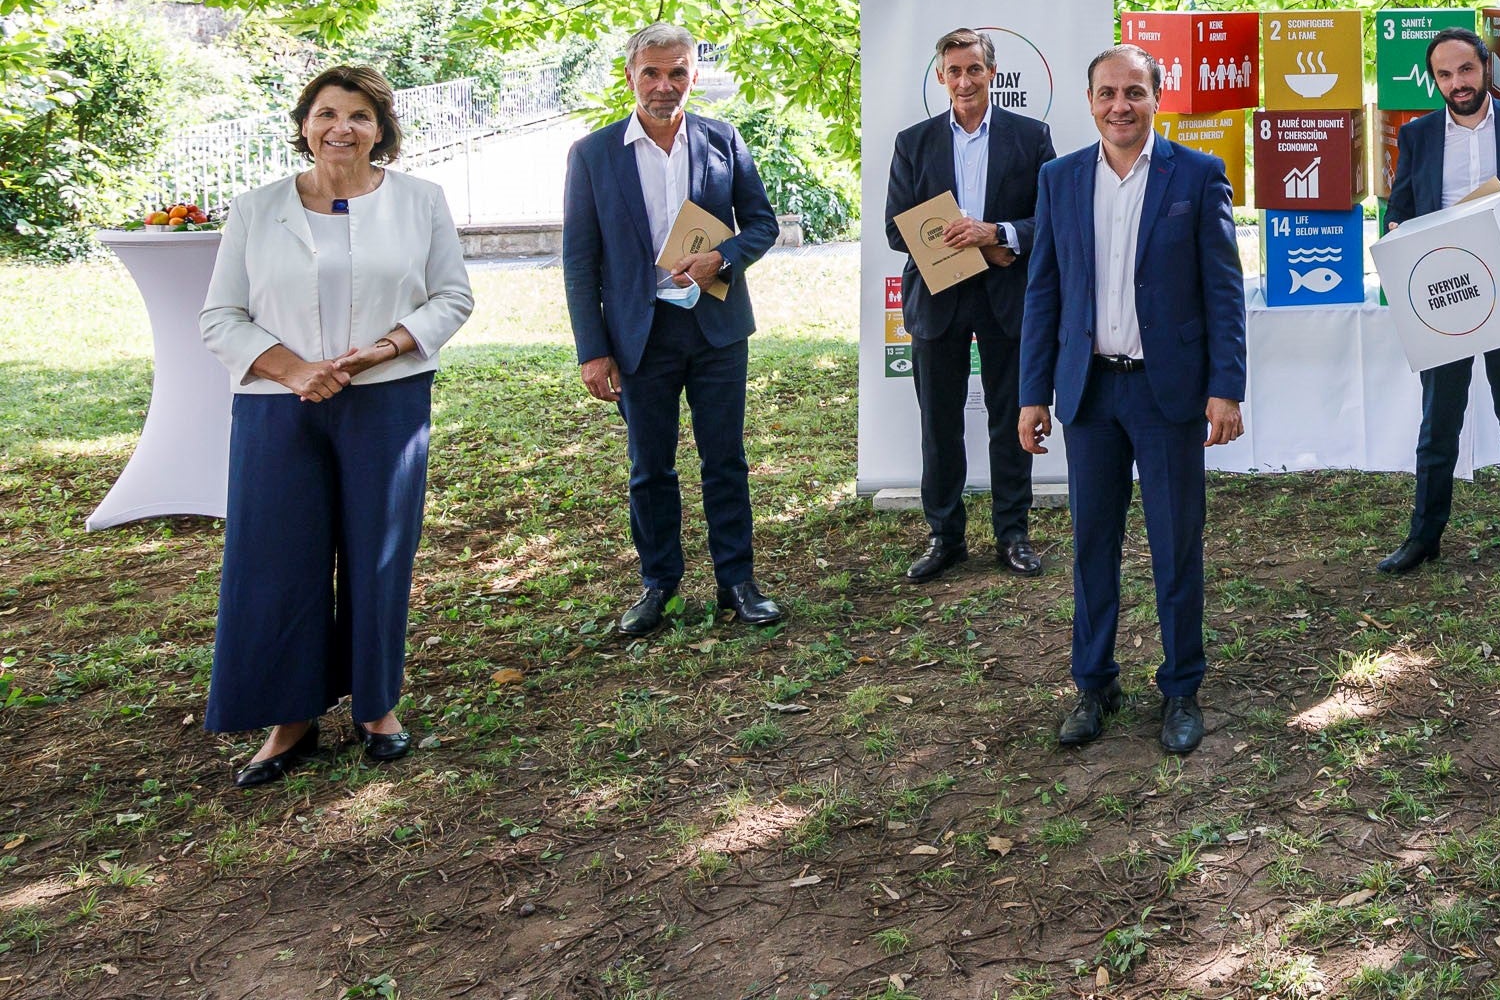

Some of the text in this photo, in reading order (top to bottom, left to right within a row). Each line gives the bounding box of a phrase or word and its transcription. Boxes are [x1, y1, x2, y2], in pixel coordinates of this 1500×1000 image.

[1209, 20, 1224, 29] KEINE
[1288, 19, 1334, 28] SCONFIGGERE
[1401, 17, 1432, 27] SANITÉ Y
[1127, 20, 1132, 40] 1
[1197, 22, 1203, 42] 1
[1270, 20, 1281, 40] 2
[1384, 19, 1395, 40] 3
[1138, 32, 1160, 40] POVERTY
[1209, 32, 1227, 41] ARMUT
[1288, 31, 1316, 40] LA FAME
[1178, 118, 1233, 129] AFFORDABLE AND
[1278, 117, 1344, 128] LAURÉ CUN DIGNITÉ
[1162, 122, 1171, 140] 7
[1260, 120, 1271, 140] 8
[1278, 129, 1328, 140] Y CHERSCIÜDA
[1178, 131, 1224, 141] CLEAN ENERGY
[1278, 143, 1318, 152] ECONOMICA
[1296, 216, 1309, 224] LIFE
[1271, 216, 1291, 237] 14
[1296, 226, 1343, 236] BELOW WATER
[1427, 273, 1471, 296] EVERYDAY
[1428, 285, 1480, 311] FOR FUTURE
